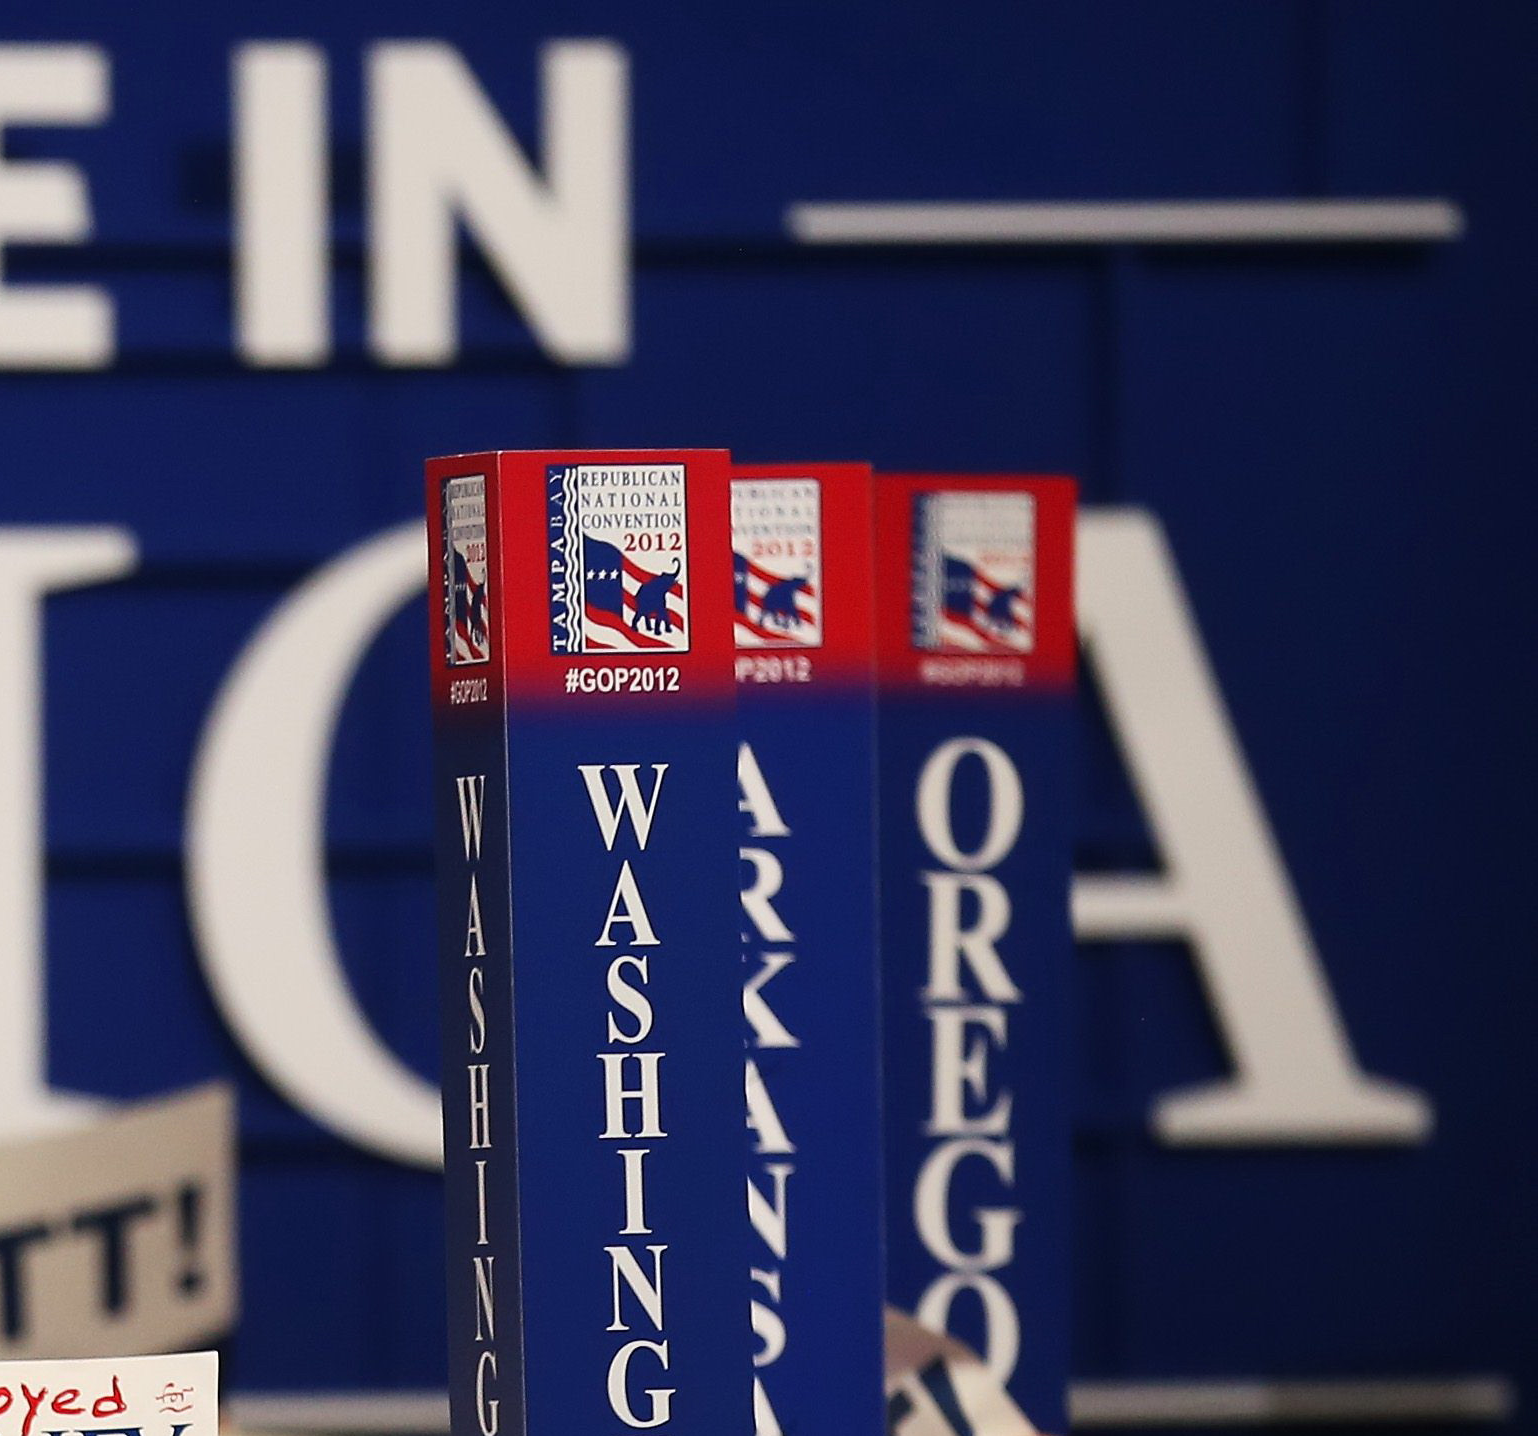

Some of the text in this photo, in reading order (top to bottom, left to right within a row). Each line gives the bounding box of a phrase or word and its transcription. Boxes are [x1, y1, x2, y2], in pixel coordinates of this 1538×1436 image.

[232, 38, 631, 368] IN
[580, 470, 682, 487] REPUBLICAN
[580, 492, 682, 508] NATIONAL
[581, 513, 682, 530] CONVENTION
[624, 532, 683, 552] 2012
[565, 666, 681, 693] #GOP2012
[734, 655, 813, 684] P2012
[911, 735, 1027, 1390] OREGO
